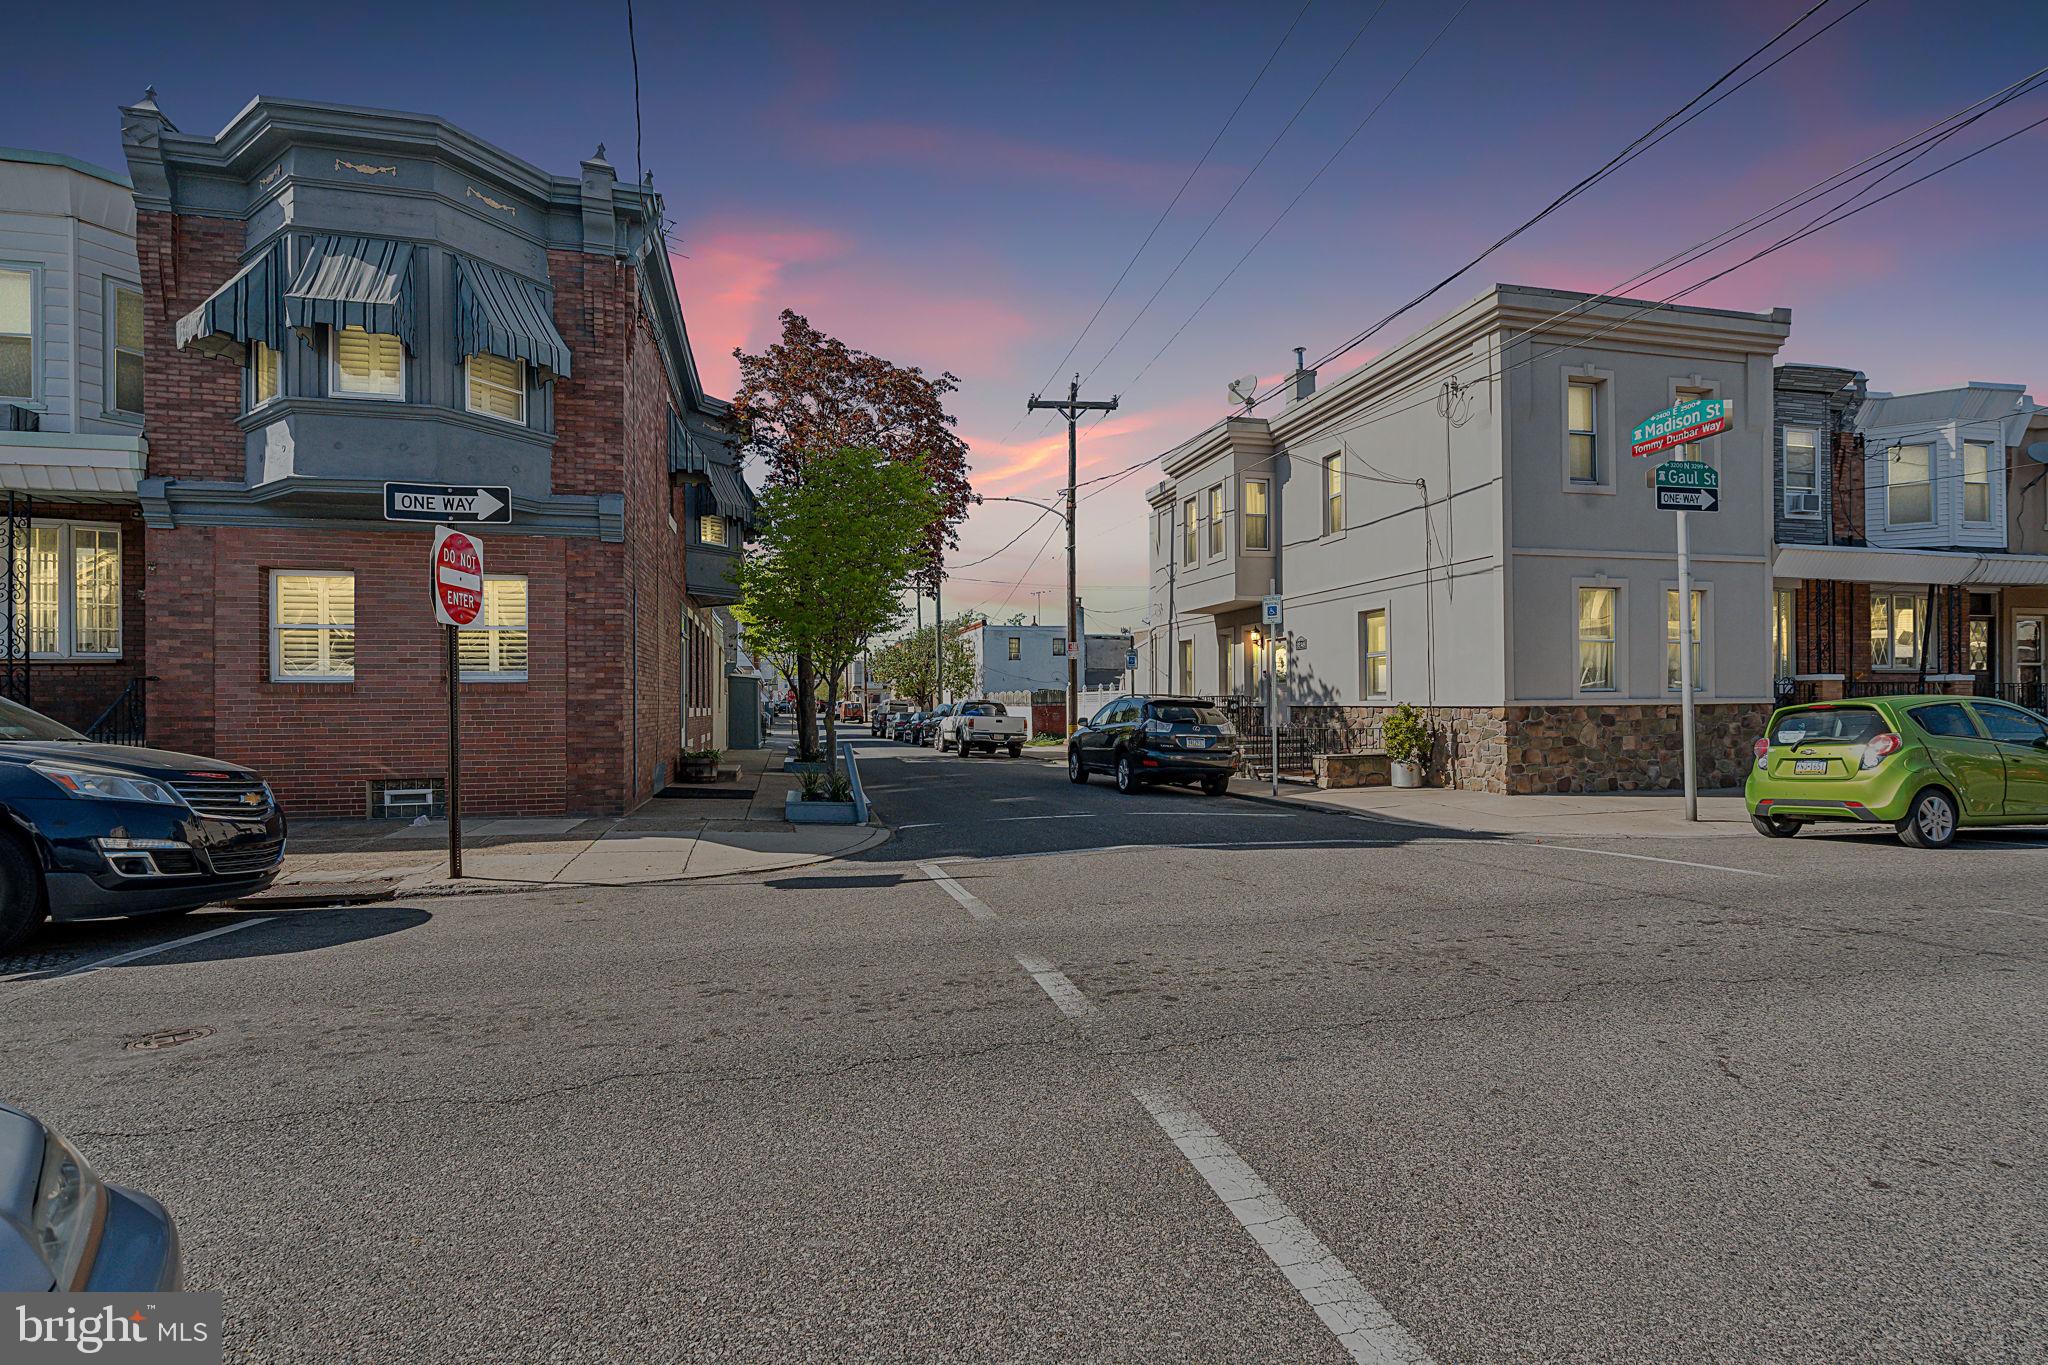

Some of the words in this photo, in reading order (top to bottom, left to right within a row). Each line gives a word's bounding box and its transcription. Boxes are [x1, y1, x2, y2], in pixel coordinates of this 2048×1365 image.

[1645, 411, 1700, 438] Madison
[1706, 403, 1721, 419] St
[1633, 439, 1664, 454] Tommy
[1666, 428, 1699, 444] Dunbar
[1702, 421, 1722, 433] Way
[1683, 462, 1690, 470] N
[1668, 469, 1699, 485] Gaul
[1703, 472, 1717, 486] St
[401, 494, 436, 511] ONE
[442, 497, 476, 512] WAY
[443, 547, 456, 564] DO
[460, 553, 476, 570] NOT
[447, 590, 475, 609] ENTER
